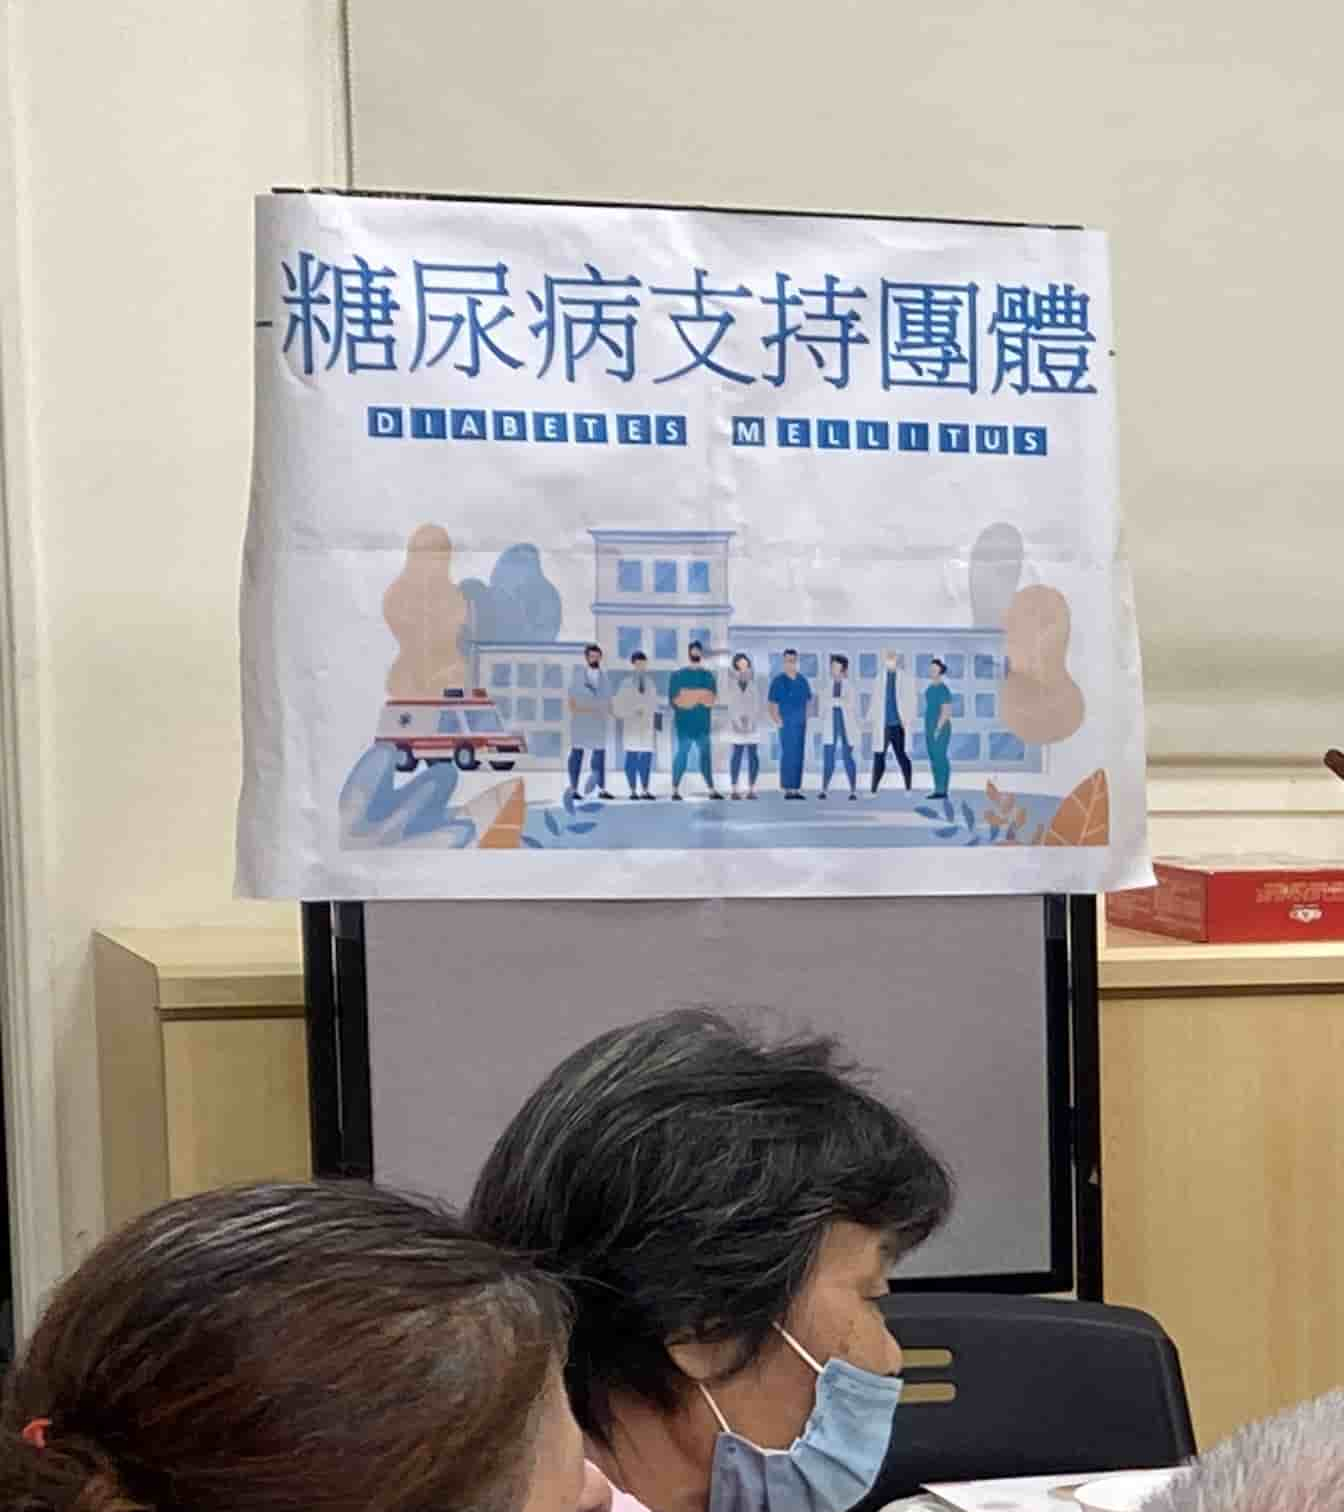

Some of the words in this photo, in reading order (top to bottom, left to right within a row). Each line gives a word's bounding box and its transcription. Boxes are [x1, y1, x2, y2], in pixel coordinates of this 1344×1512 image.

[279, 250, 1098, 397] 糖尿病支持團體
[370, 408, 686, 446] DIABETES
[734, 417, 1047, 456] MELLITUS
